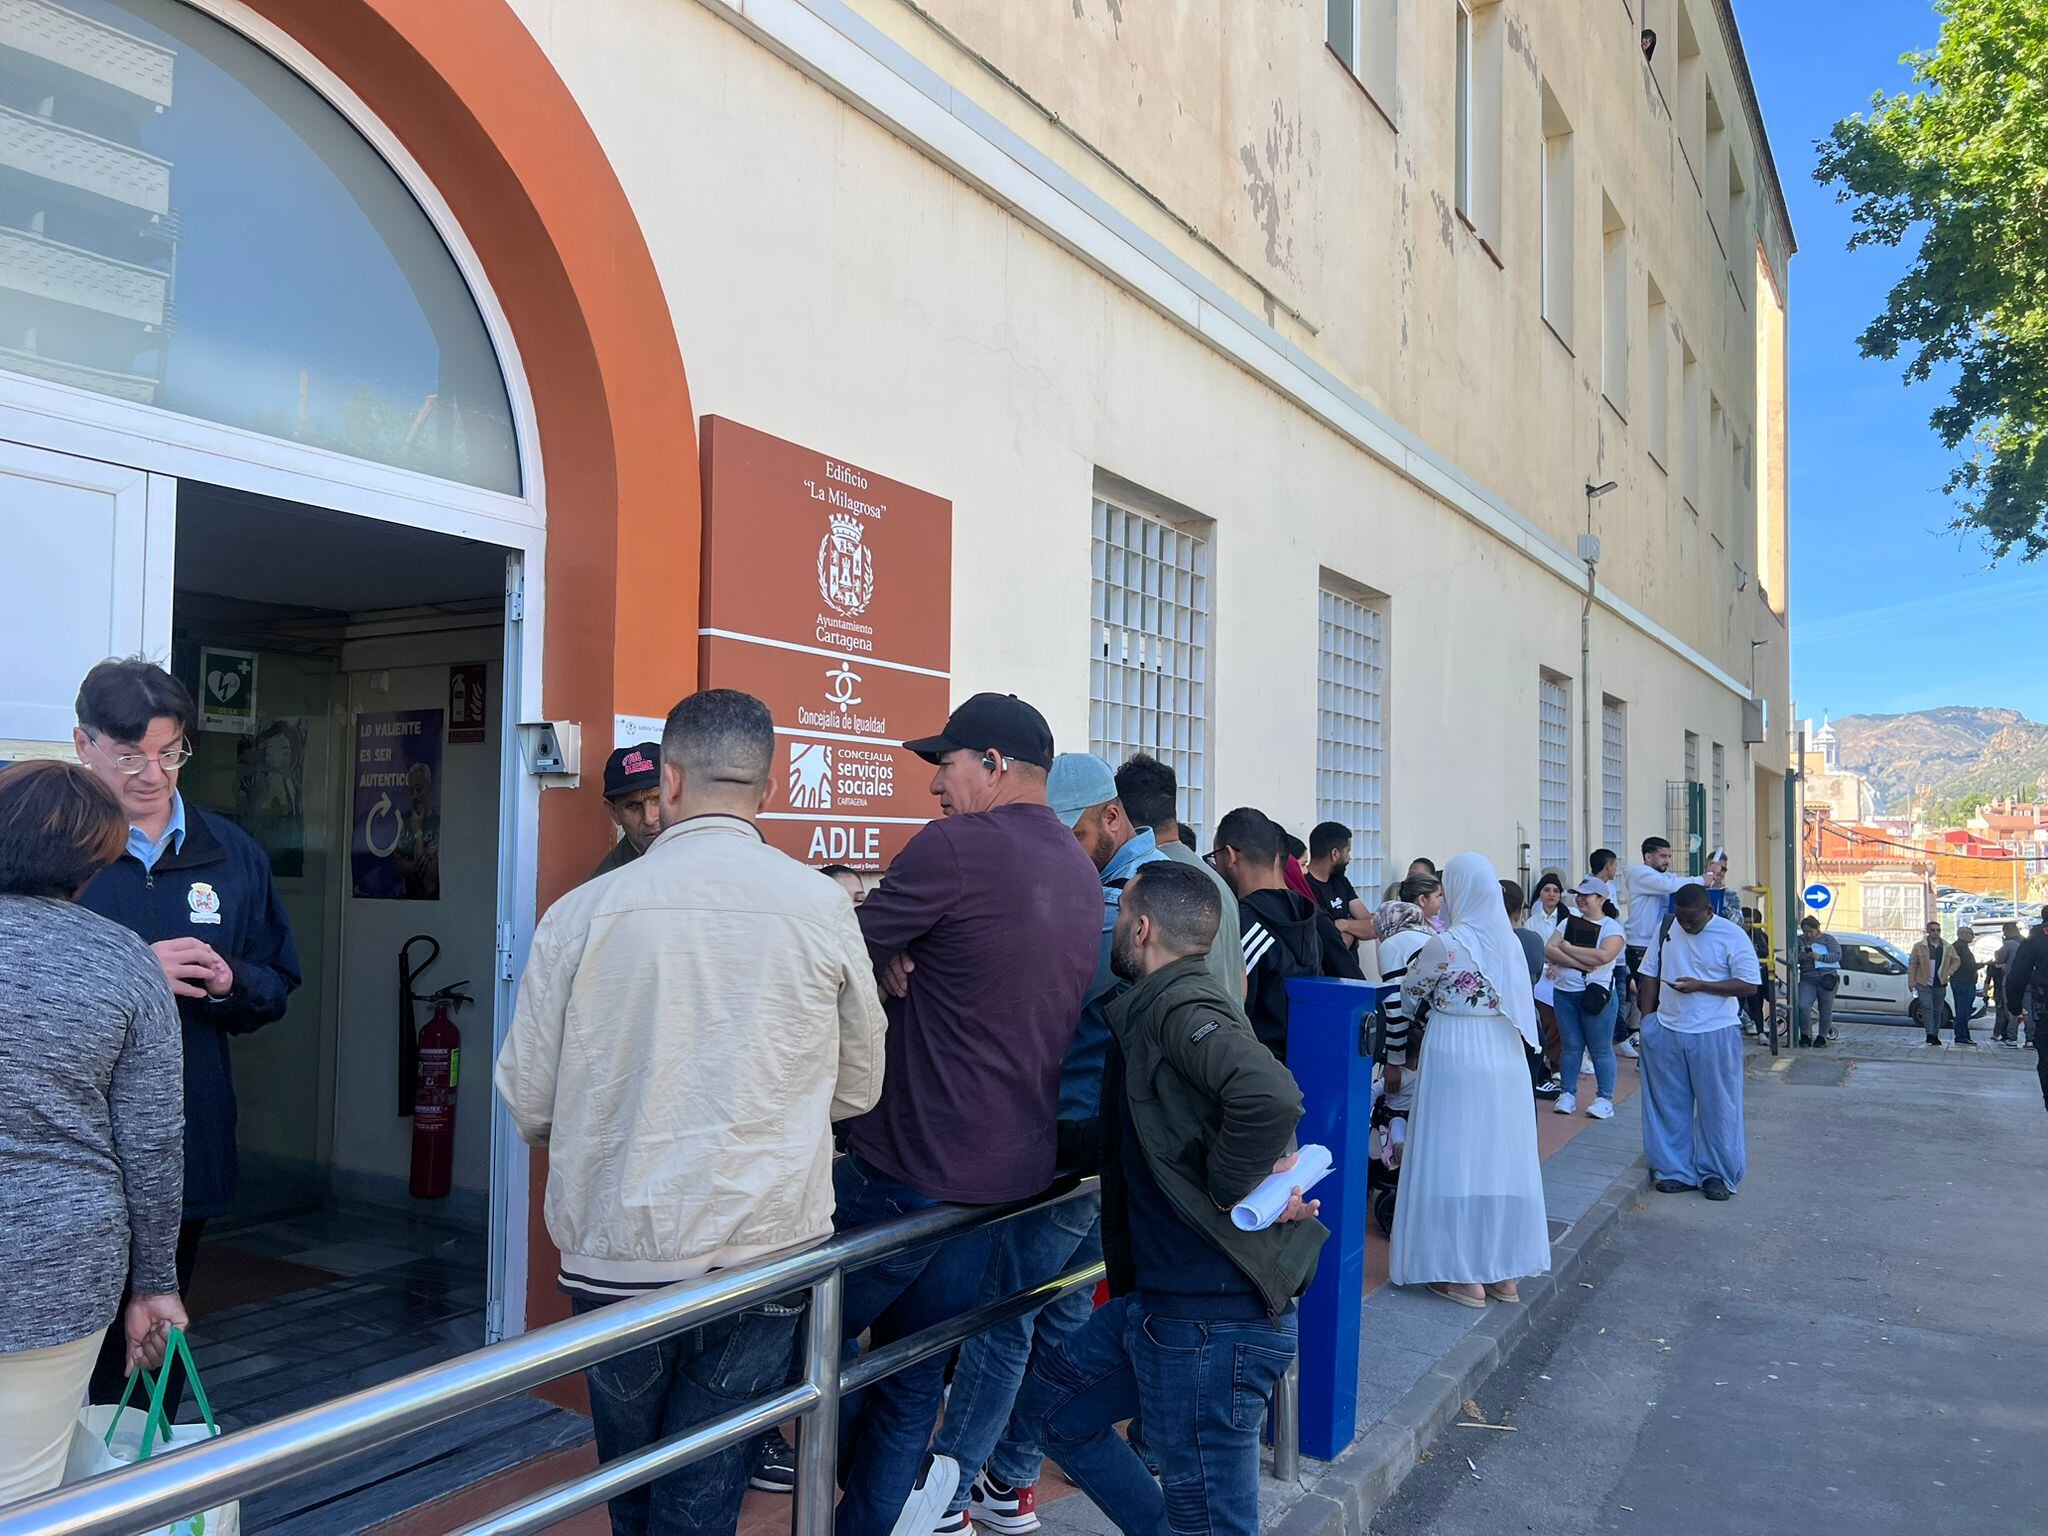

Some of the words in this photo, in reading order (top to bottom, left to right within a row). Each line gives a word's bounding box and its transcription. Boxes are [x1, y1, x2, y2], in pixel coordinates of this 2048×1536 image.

[825, 460, 868, 490] Edificio
[816, 613, 873, 635] Ayuntamiento
[816, 626, 873, 651] Cartagena
[360, 723, 372, 738] LO
[374, 721, 422, 736] VALIENTE
[798, 706, 840, 730] Concejalía
[841, 712, 852, 730] de
[853, 714, 885, 734] Igualdad
[360, 749, 371, 762] ES
[374, 748, 392, 761] SER
[837, 749, 893, 762] CONCEJALIA
[837, 760, 893, 780] servicios
[837, 776, 893, 797] sociales
[837, 797, 868, 807] CARTAGENA
[807, 826, 880, 859] ADLE
